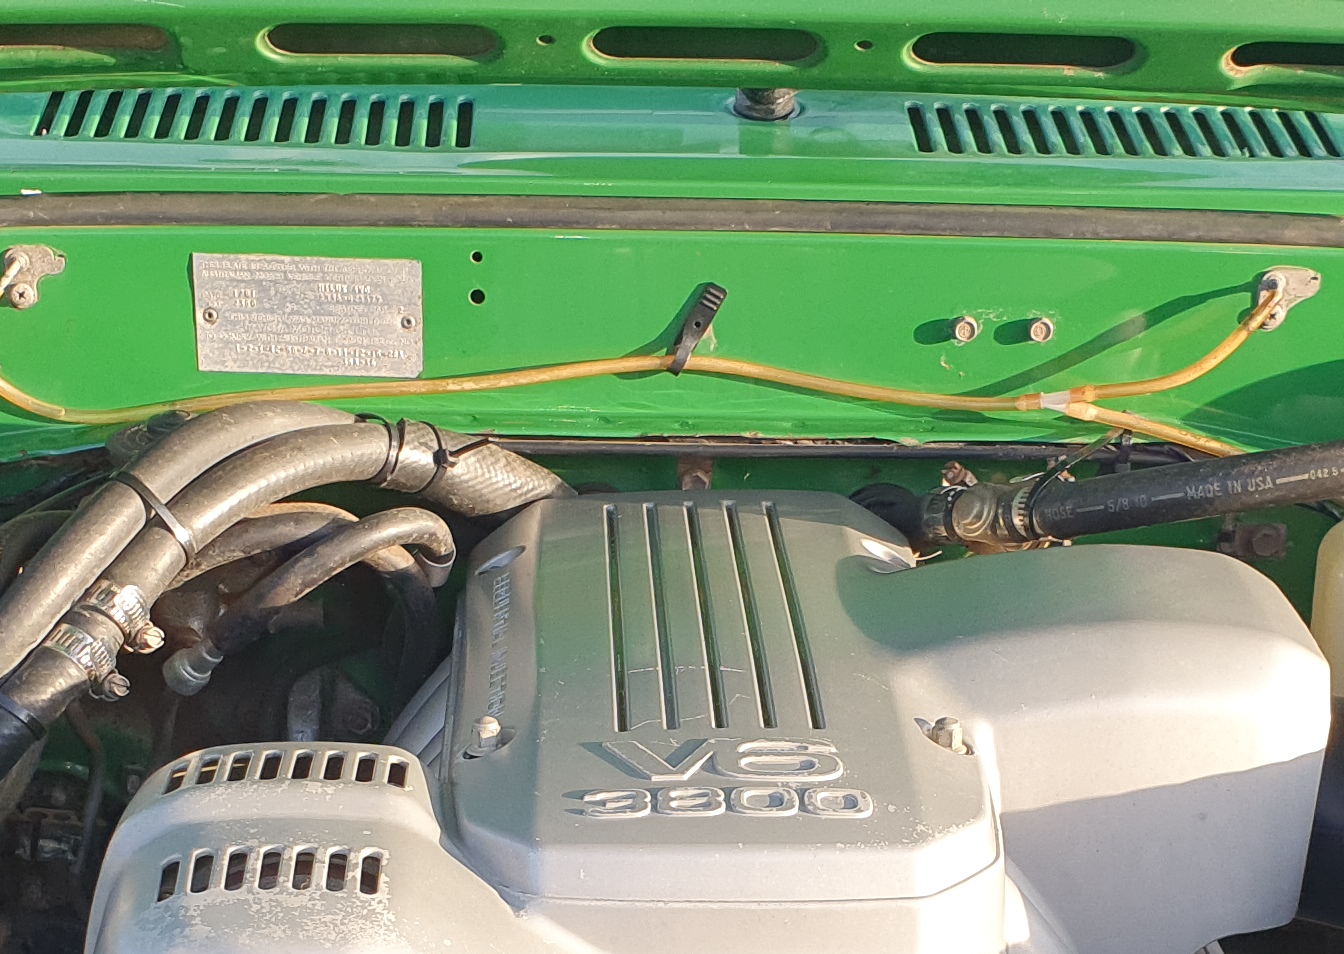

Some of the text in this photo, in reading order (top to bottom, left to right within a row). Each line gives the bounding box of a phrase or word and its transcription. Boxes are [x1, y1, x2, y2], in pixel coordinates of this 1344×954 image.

[1185, 481, 1222, 500] MADE
[1227, 479, 1242, 494] IN
[1246, 474, 1274, 492] USA
[602, 738, 844, 782] V6
[582, 787, 875, 819] 3800
